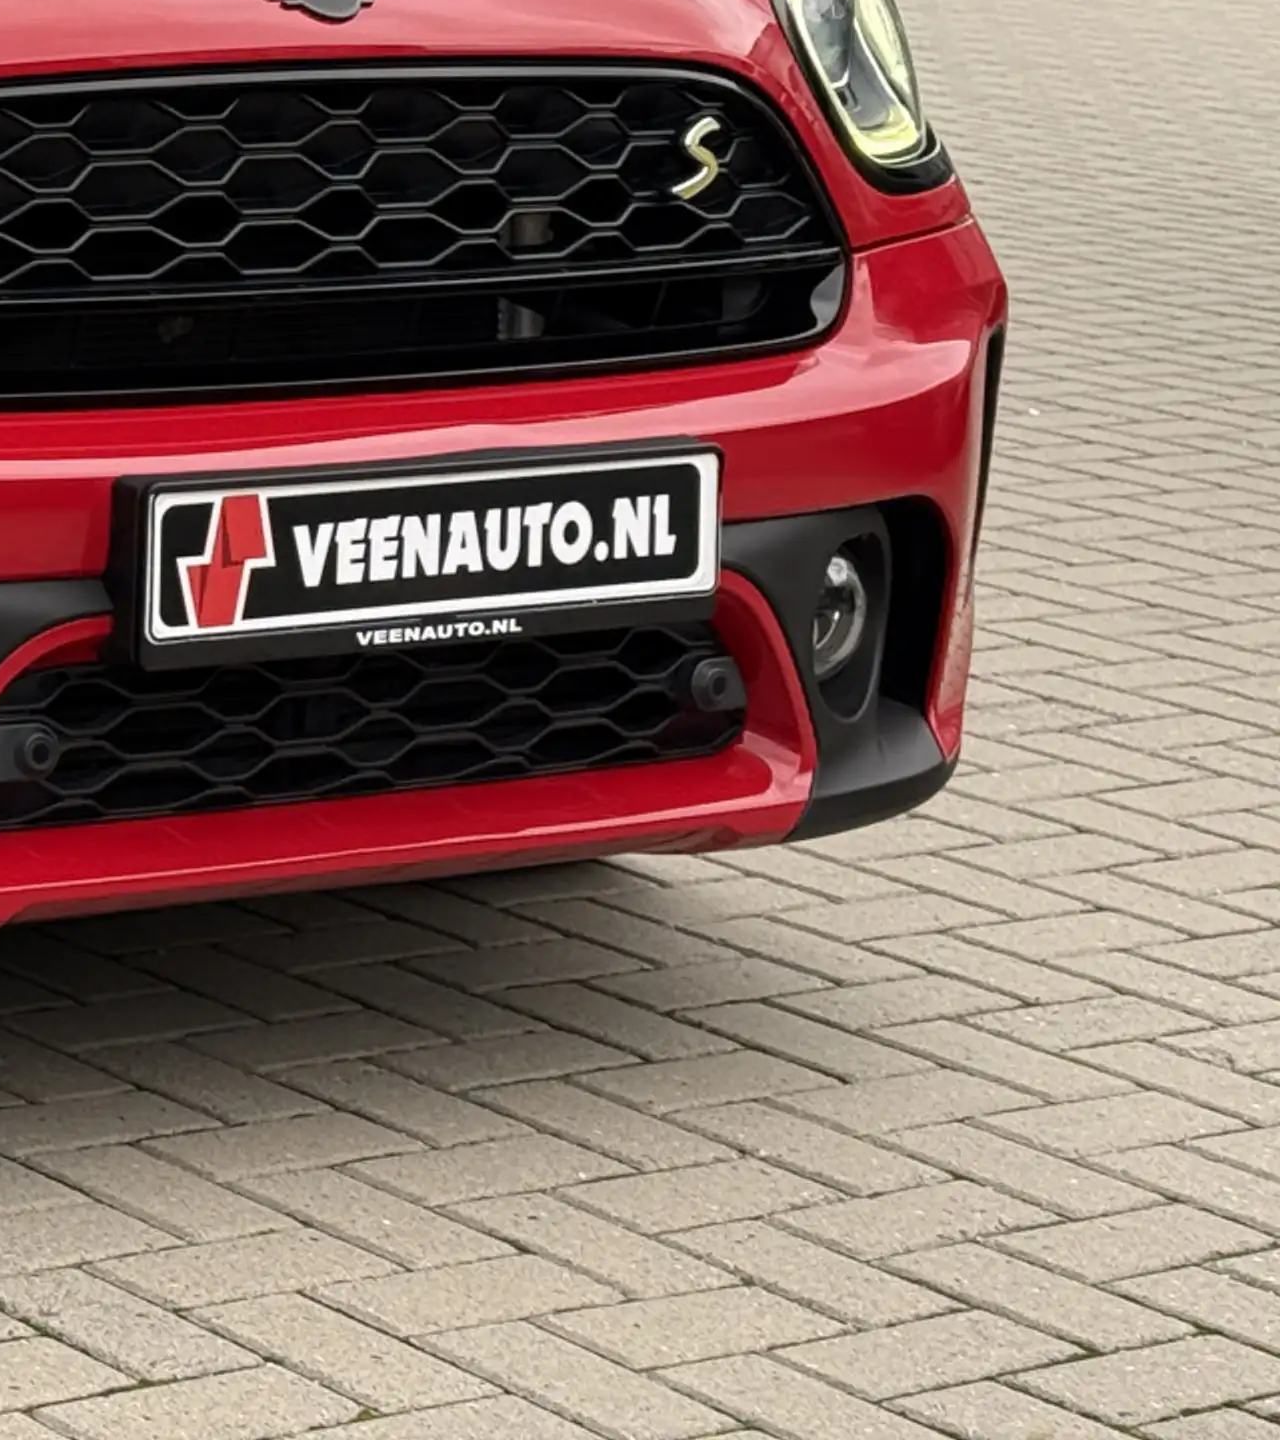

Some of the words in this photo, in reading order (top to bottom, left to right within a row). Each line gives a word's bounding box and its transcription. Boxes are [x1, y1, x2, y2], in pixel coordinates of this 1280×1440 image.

[671, 115, 722, 201] S
[291, 494, 677, 589] VEENAUTO.NL
[354, 618, 523, 647] VEENAUTO.NL
